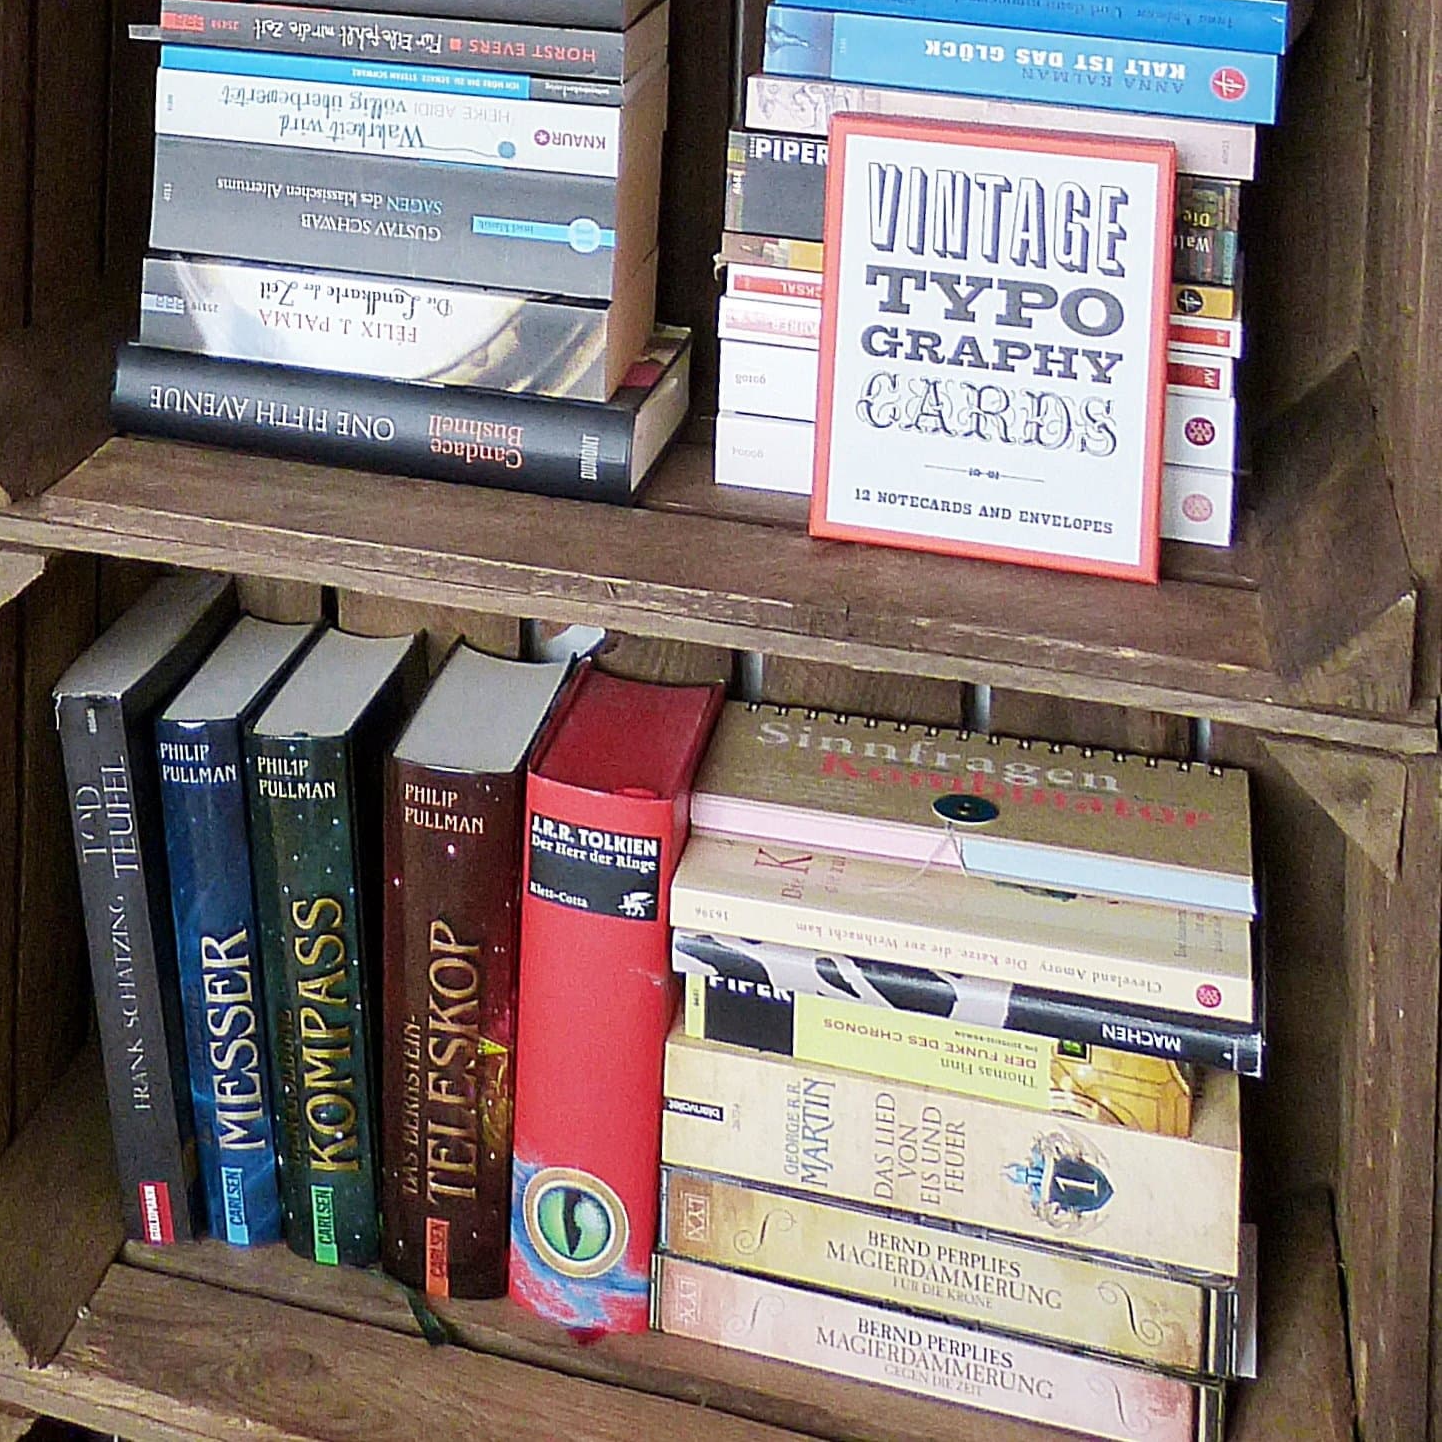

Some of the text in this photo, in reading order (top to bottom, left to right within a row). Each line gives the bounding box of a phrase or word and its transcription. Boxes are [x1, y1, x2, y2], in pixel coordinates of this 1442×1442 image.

[252, 18, 442, 54] Für Eile fehlt mir die Zeit
[468, 39, 596, 63] HORST EVERS
[924, 39, 1186, 79] KALT IST DAS GLÜCK
[349, 90, 408, 121] völlig
[278, 114, 425, 150] Wahrheit wird
[551, 131, 606, 150] KNAUR
[756, 137, 828, 166] PIPER
[216, 177, 442, 217] SAGEN des klassischen Altertums
[300, 212, 442, 242] GUSTAV SCHWAB
[258, 308, 418, 347] FÉLIX PALMA
[856, 161, 1129, 458] VINTAGE TYPO GRAPHY CARDS
[148, 384, 396, 441] ONE FIFTH AVENUE
[428, 414, 525, 469] Candace Bushnell
[580, 433, 600, 481] DUMONT
[854, 487, 1114, 535] 12 NOTECARDS AND ENVELOPES
[159, 742, 237, 784] PHILIP PULLMAN
[257, 755, 336, 799] PHILIP PULLMAN
[755, 721, 1121, 795] Sinnfragen
[404, 783, 484, 835] PHILIP PULLMAN
[531, 832, 656, 873] Der Herr der Ringe
[577, 828, 658, 857] TOLKIEN
[200, 928, 267, 1152] MESSER
[290, 896, 361, 1175] KOMPASS
[822, 1018, 903, 1045] CHRONOS
[906, 1035, 939, 1050] DES
[943, 1041, 999, 1063] FUNKE
[1101, 1022, 1182, 1052] MACHEN
[426, 918, 481, 1205] TELESKOP
[1002, 1053, 1038, 1070] DER
[800, 1077, 836, 1188] MARTIN
[873, 1091, 896, 1200] DAS LIED
[897, 1123, 918, 1178] VON
[920, 1106, 942, 1206] EIS UND
[944, 1120, 966, 1194] FEUER
[222, 1169, 245, 1227] CARLSEN
[314, 1189, 334, 1244] CARLSEN
[868, 1229, 1022, 1279] BERND PERPLIES
[858, 1317, 1015, 1369] BERND PERPLIES
